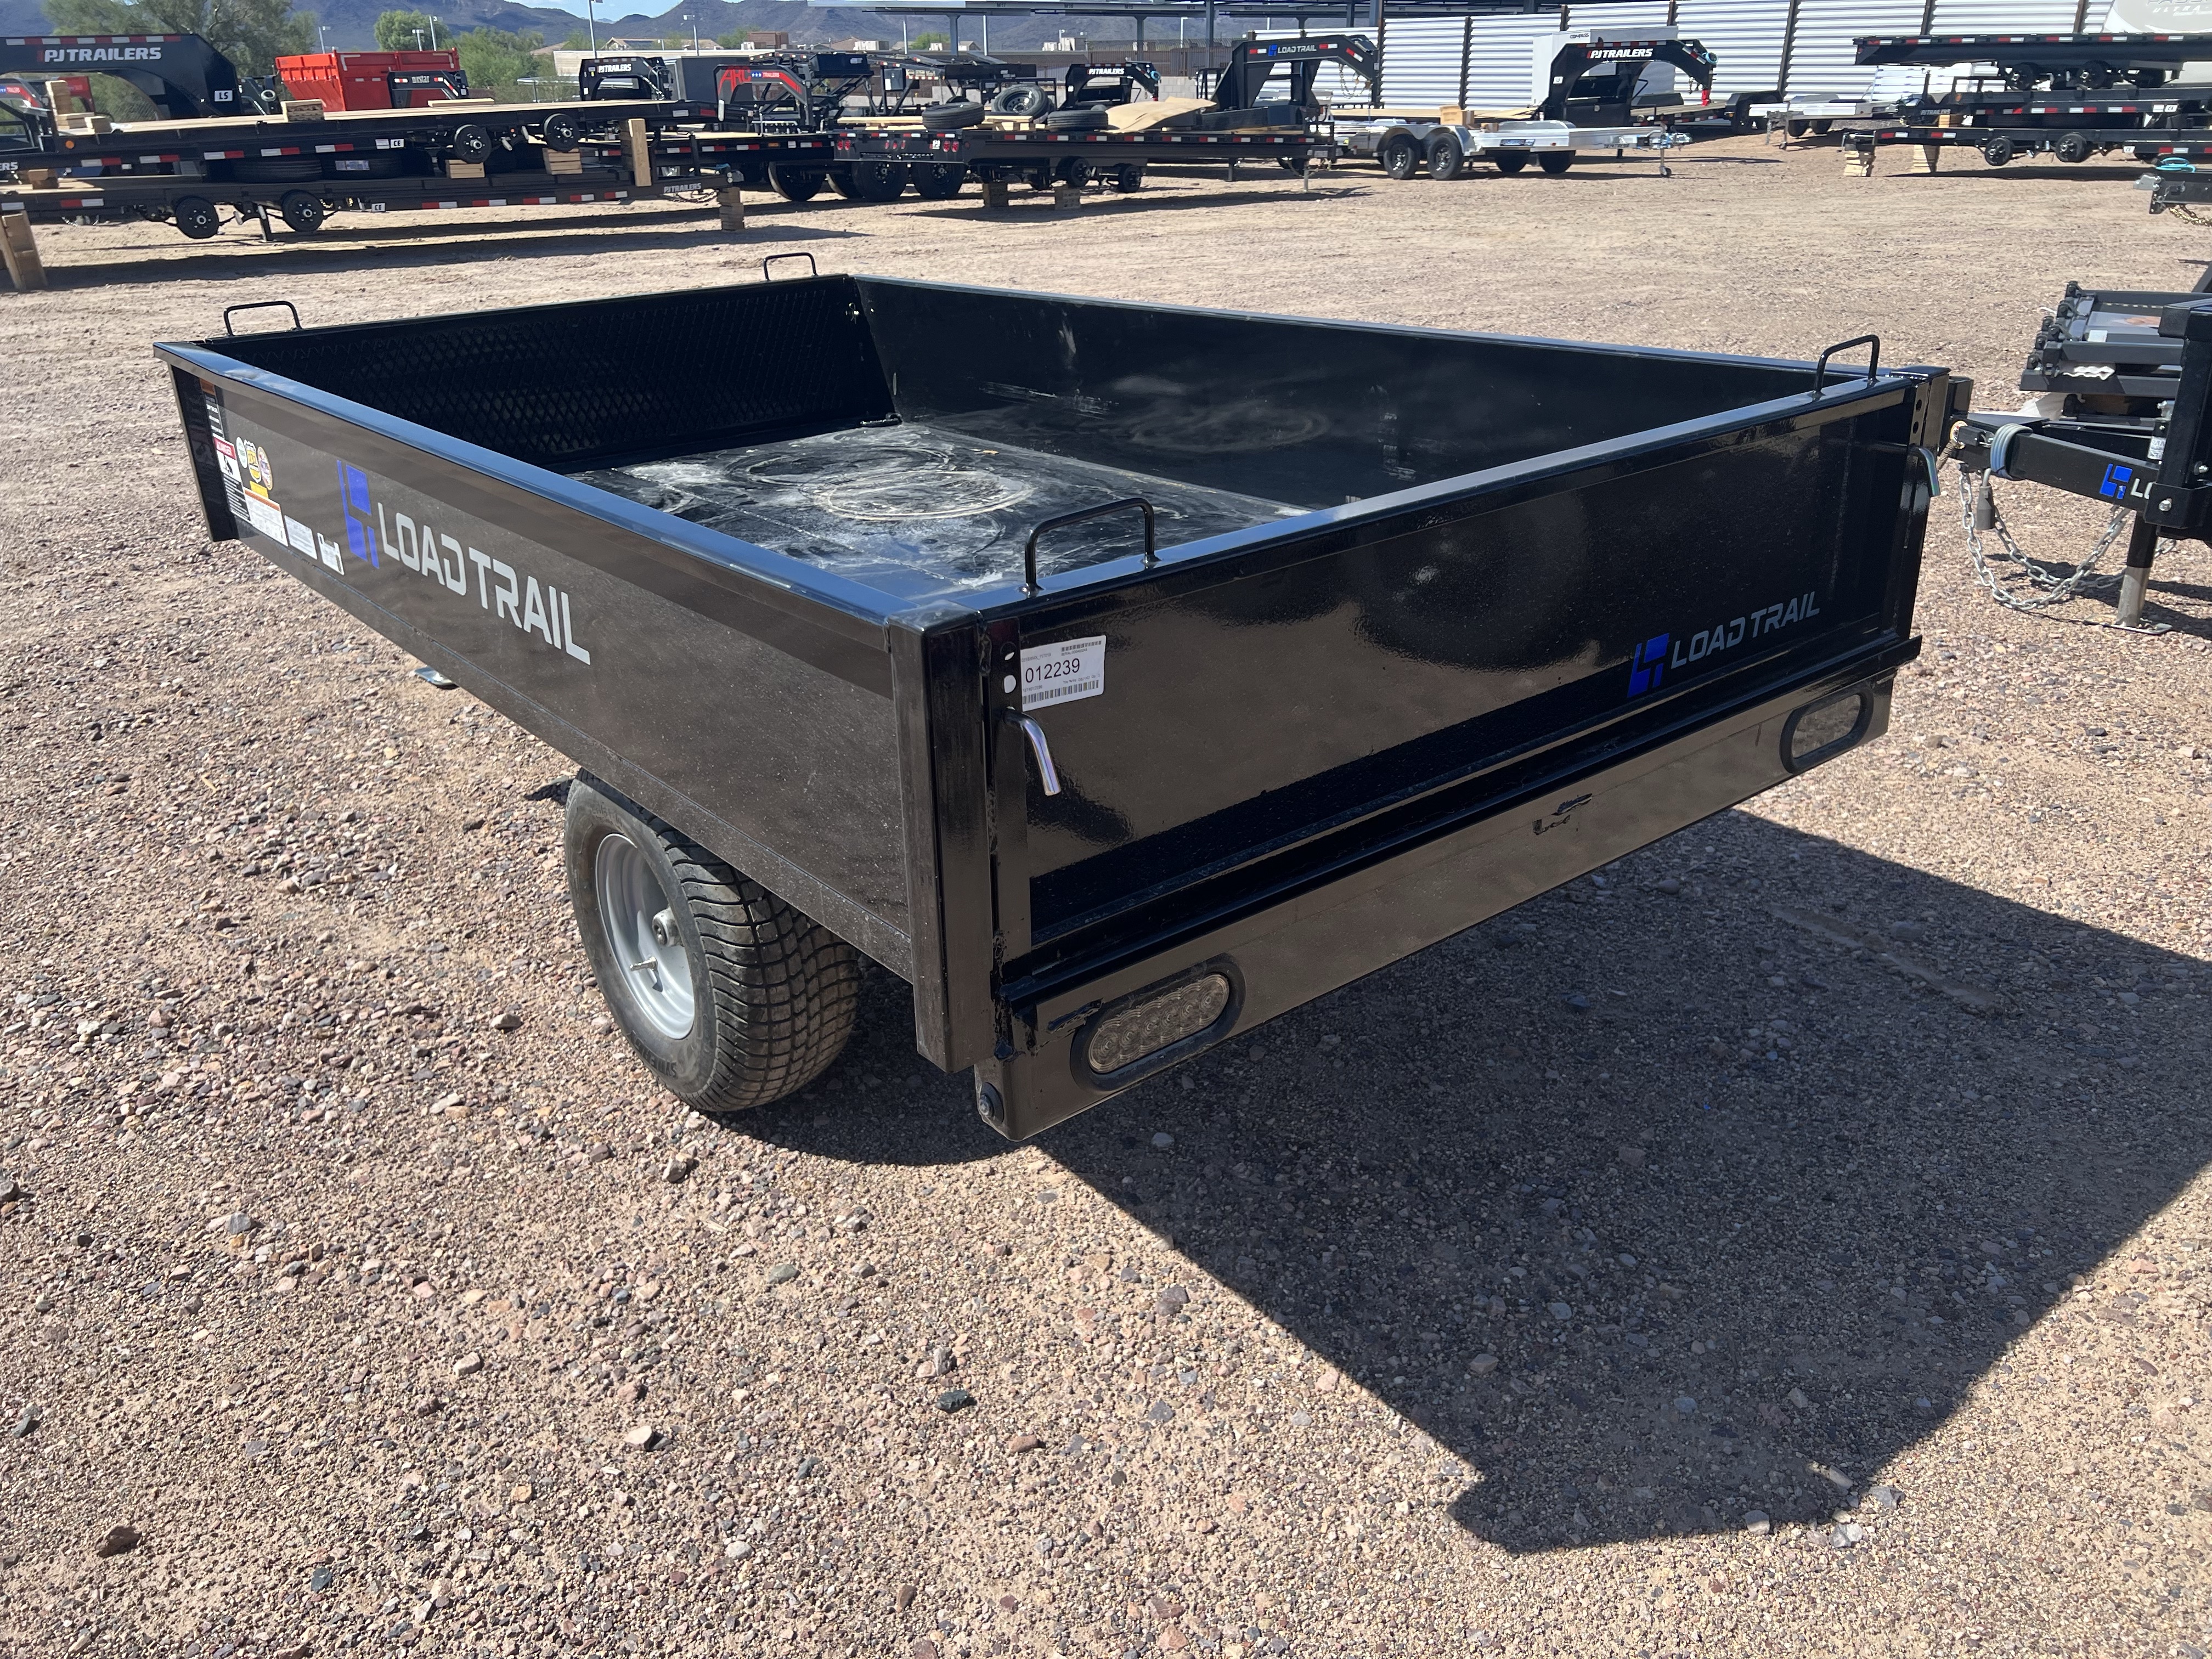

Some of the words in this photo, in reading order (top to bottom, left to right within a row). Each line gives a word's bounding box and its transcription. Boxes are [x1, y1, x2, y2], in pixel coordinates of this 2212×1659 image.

[44, 49, 65, 63] PJ
[66, 47, 161, 61] TRAILERS
[1296, 44, 1317, 53] TRAIL
[1603, 48, 1654, 58] TRAILERS
[605, 64, 631, 72] TRAILERS
[219, 92, 228, 100] LS
[377, 501, 467, 596] LOAD
[469, 546, 591, 665] TRAIL
[1671, 617, 1746, 669] LOAD
[1751, 591, 1820, 639] TRAIL
[1025, 658, 1080, 683] 012239
